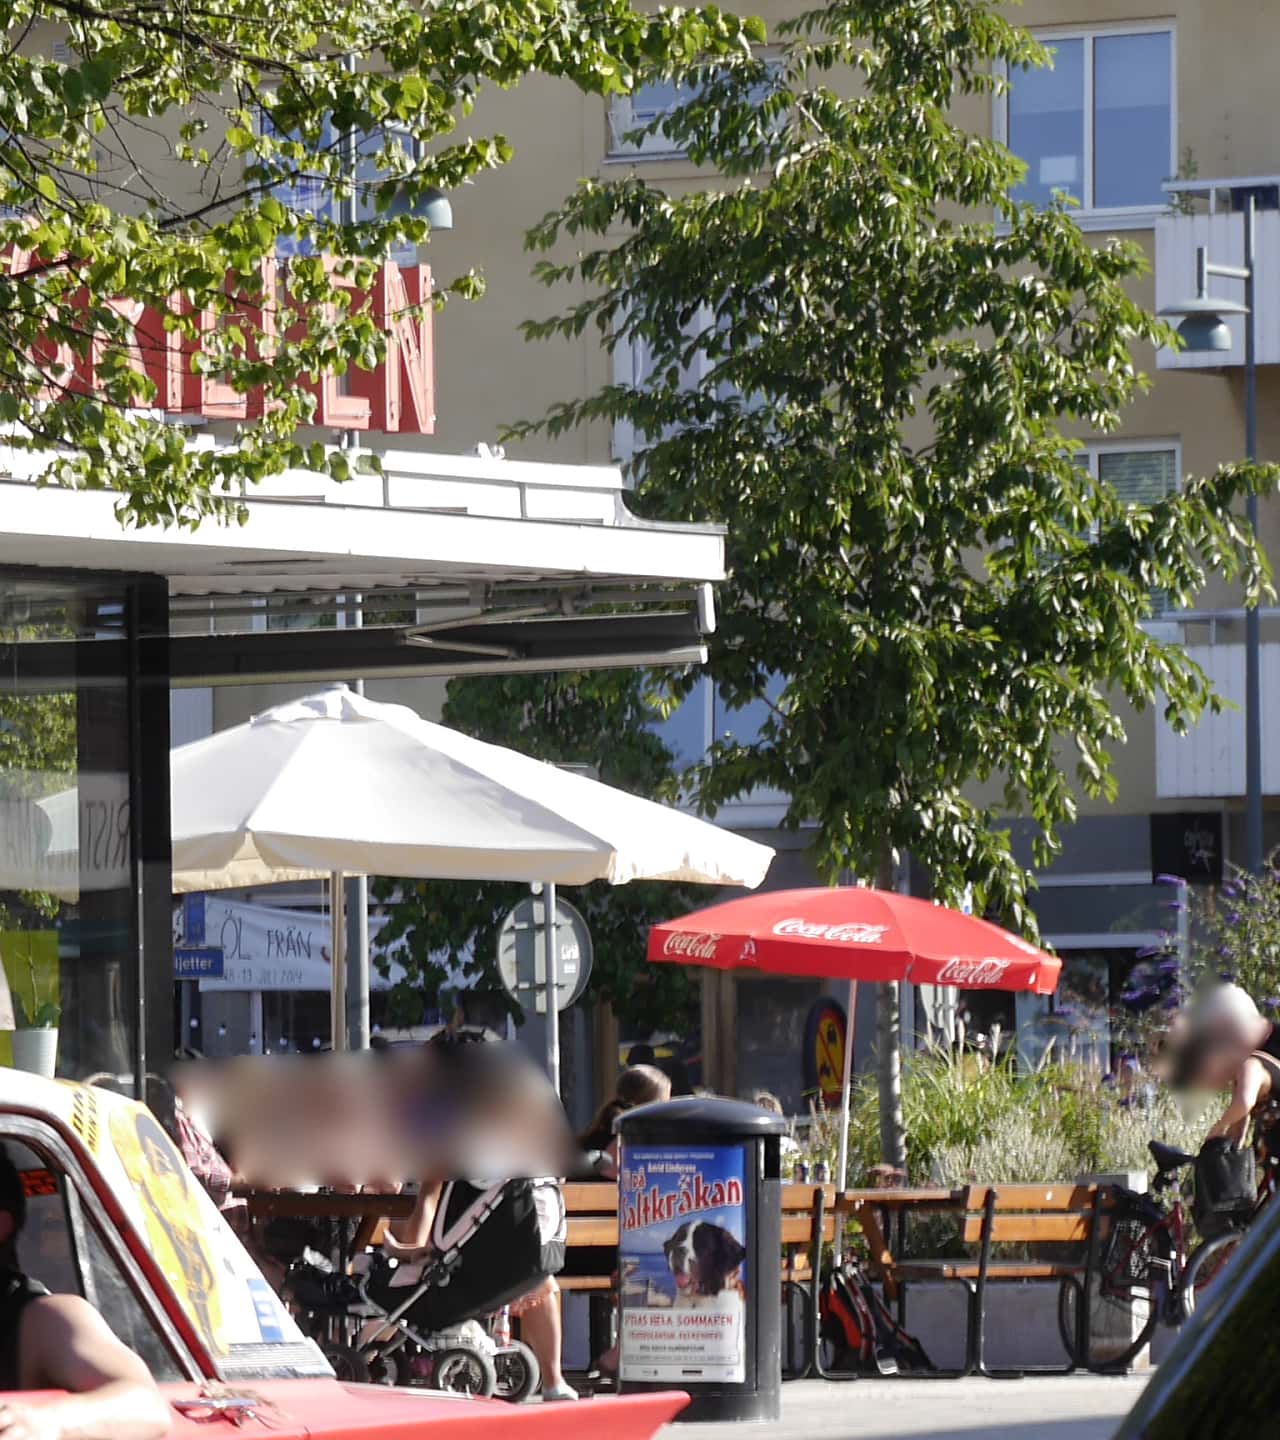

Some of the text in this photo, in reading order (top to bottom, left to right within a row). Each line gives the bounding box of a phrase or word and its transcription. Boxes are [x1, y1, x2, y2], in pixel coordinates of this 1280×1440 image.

[220, 909, 252, 960] ÖL
[663, 930, 722, 959] Coca-Cola
[772, 918, 888, 943] Coca-Cola
[937, 957, 1013, 985] Coca-Cola
